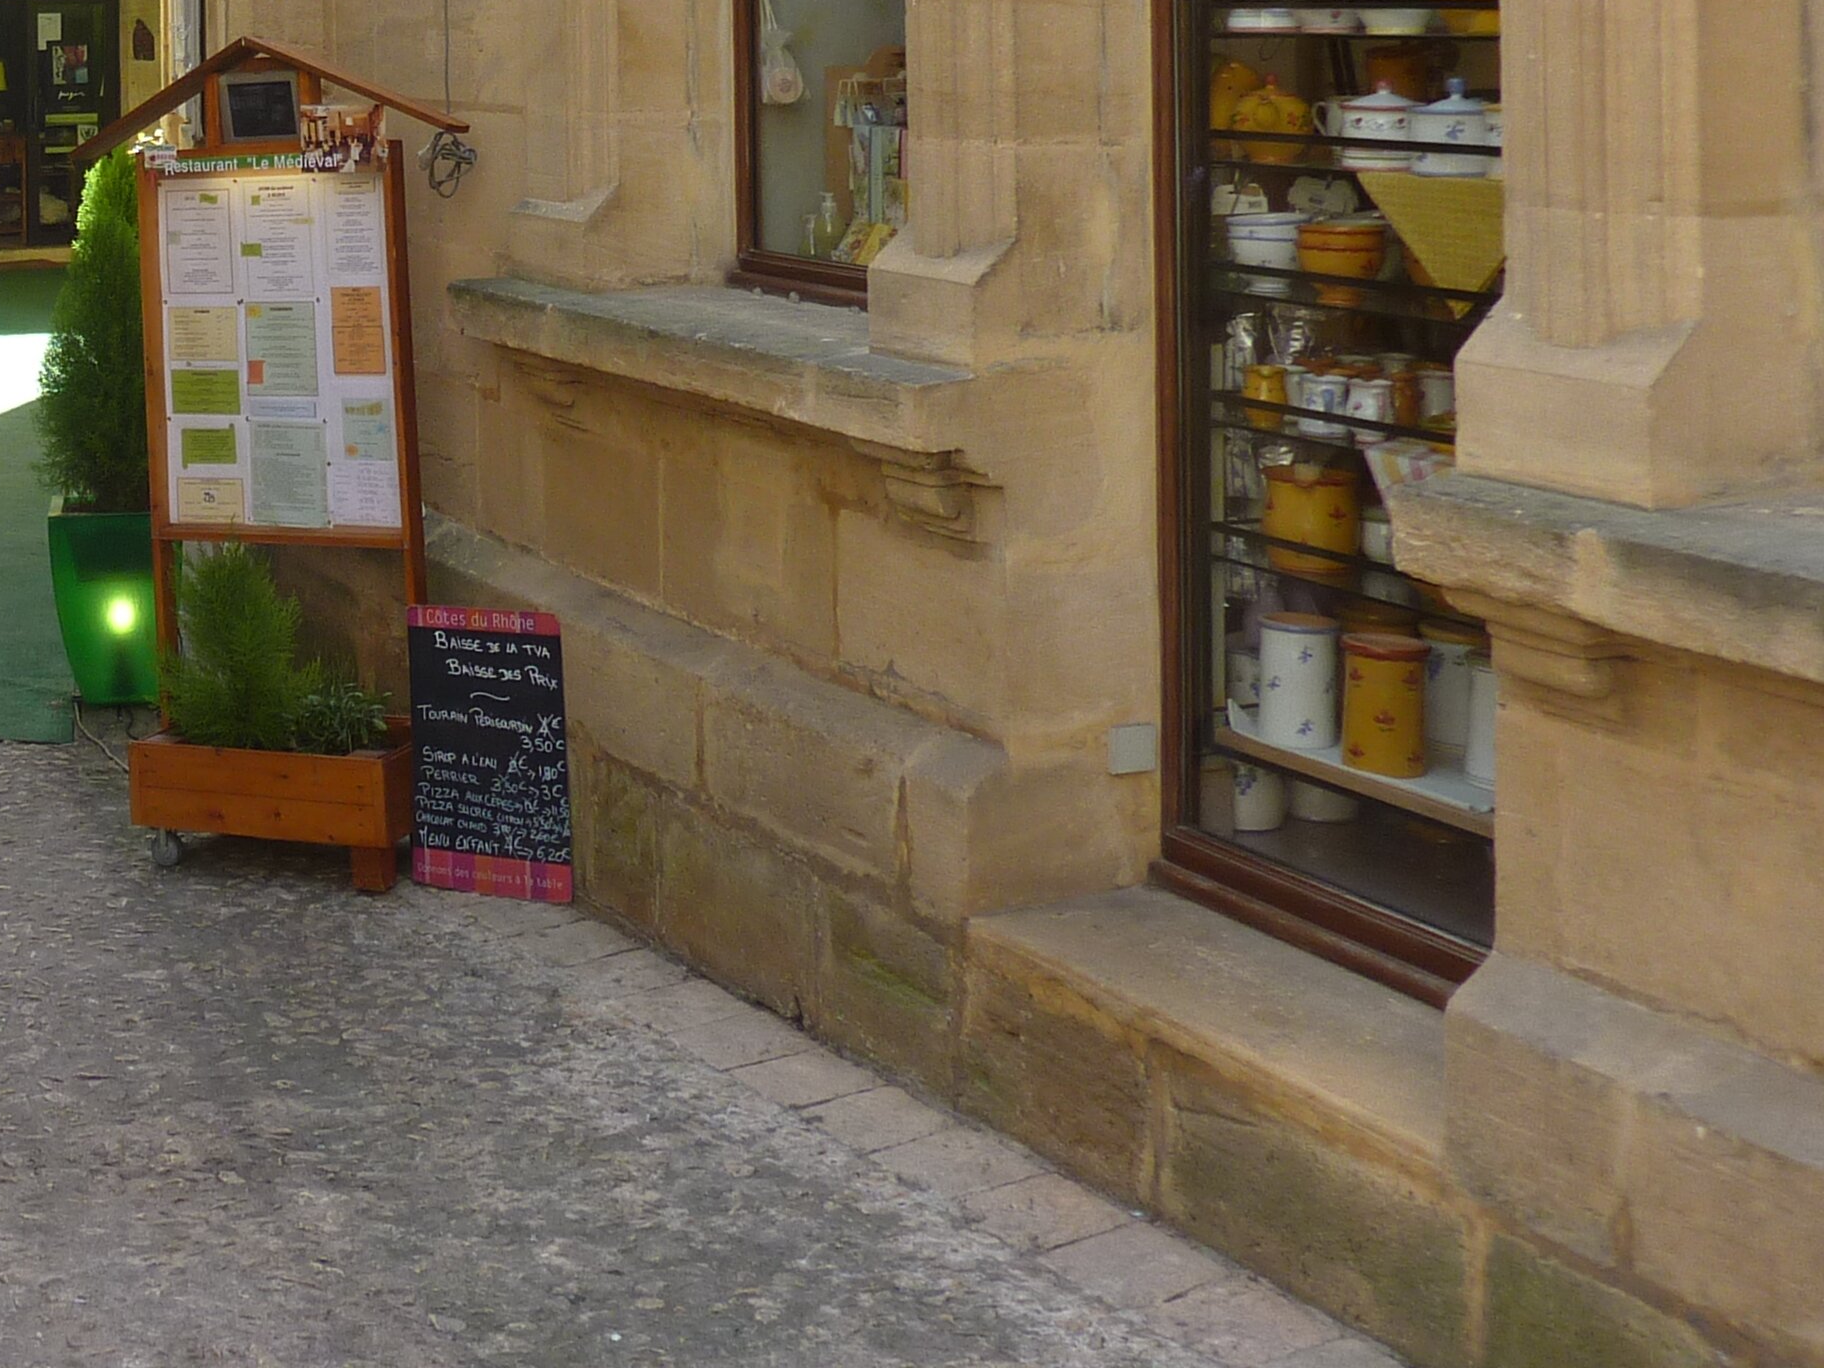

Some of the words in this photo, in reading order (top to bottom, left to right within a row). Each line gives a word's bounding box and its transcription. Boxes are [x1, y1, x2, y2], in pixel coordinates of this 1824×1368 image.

[164, 158, 238, 176] Restaurant
[426, 608, 466, 626] Côtes
[471, 614, 487, 627] du
[492, 613, 534, 631] Rhône
[486, 642, 501, 653] DE
[506, 642, 518, 654] LA
[522, 644, 550, 659] TVA
[498, 668, 521, 681] DES
[416, 704, 468, 724] TOURAIN
[422, 746, 456, 764] SIROP
[462, 753, 469, 764] A
[421, 765, 480, 785] PERRIER
[418, 782, 459, 799] PIZZA
[415, 795, 454, 812] PIZZA
[418, 825, 450, 849] MENU
[455, 834, 500, 854] ENFANT
[536, 876, 564, 890] table
